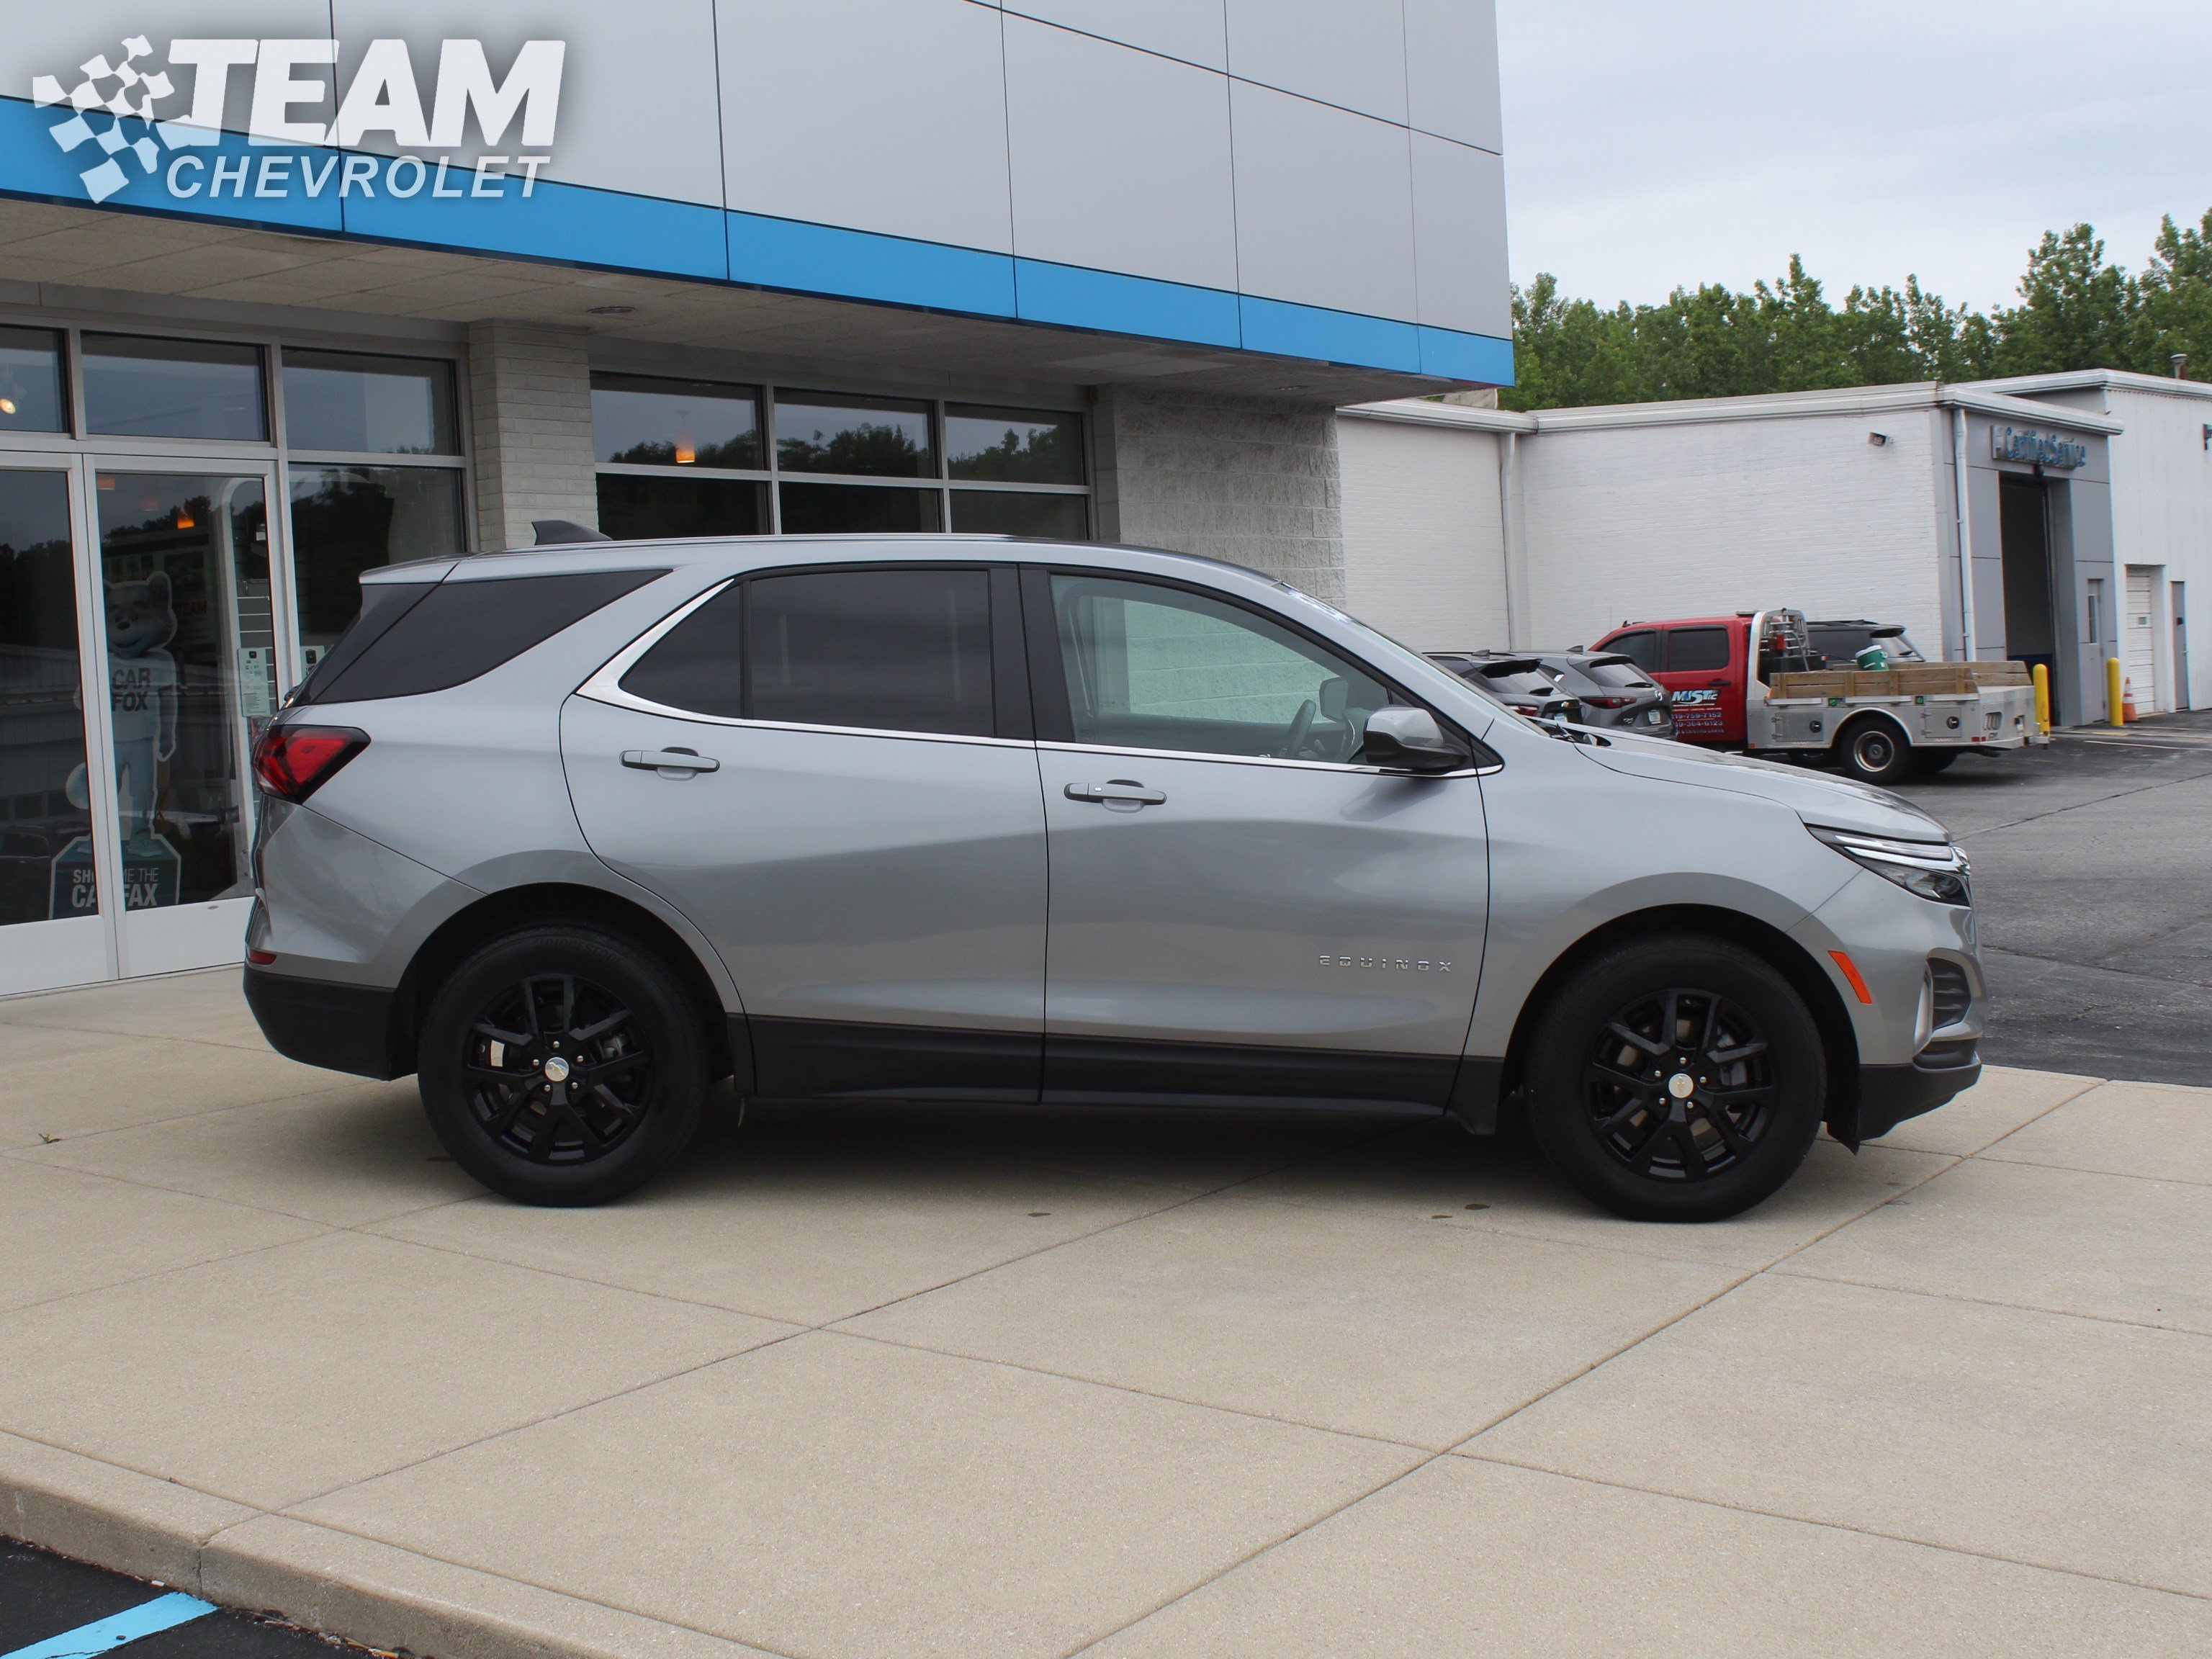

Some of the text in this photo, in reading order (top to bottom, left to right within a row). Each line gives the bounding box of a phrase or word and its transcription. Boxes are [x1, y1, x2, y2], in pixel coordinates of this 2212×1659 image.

[2051, 434, 2086, 467] Service
[112, 667, 150, 690] CAR
[112, 691, 148, 712] FOX
[139, 868, 159, 882] THE
[72, 884, 159, 908] CAFAX
[1319, 955, 1452, 972] EQUINOX
